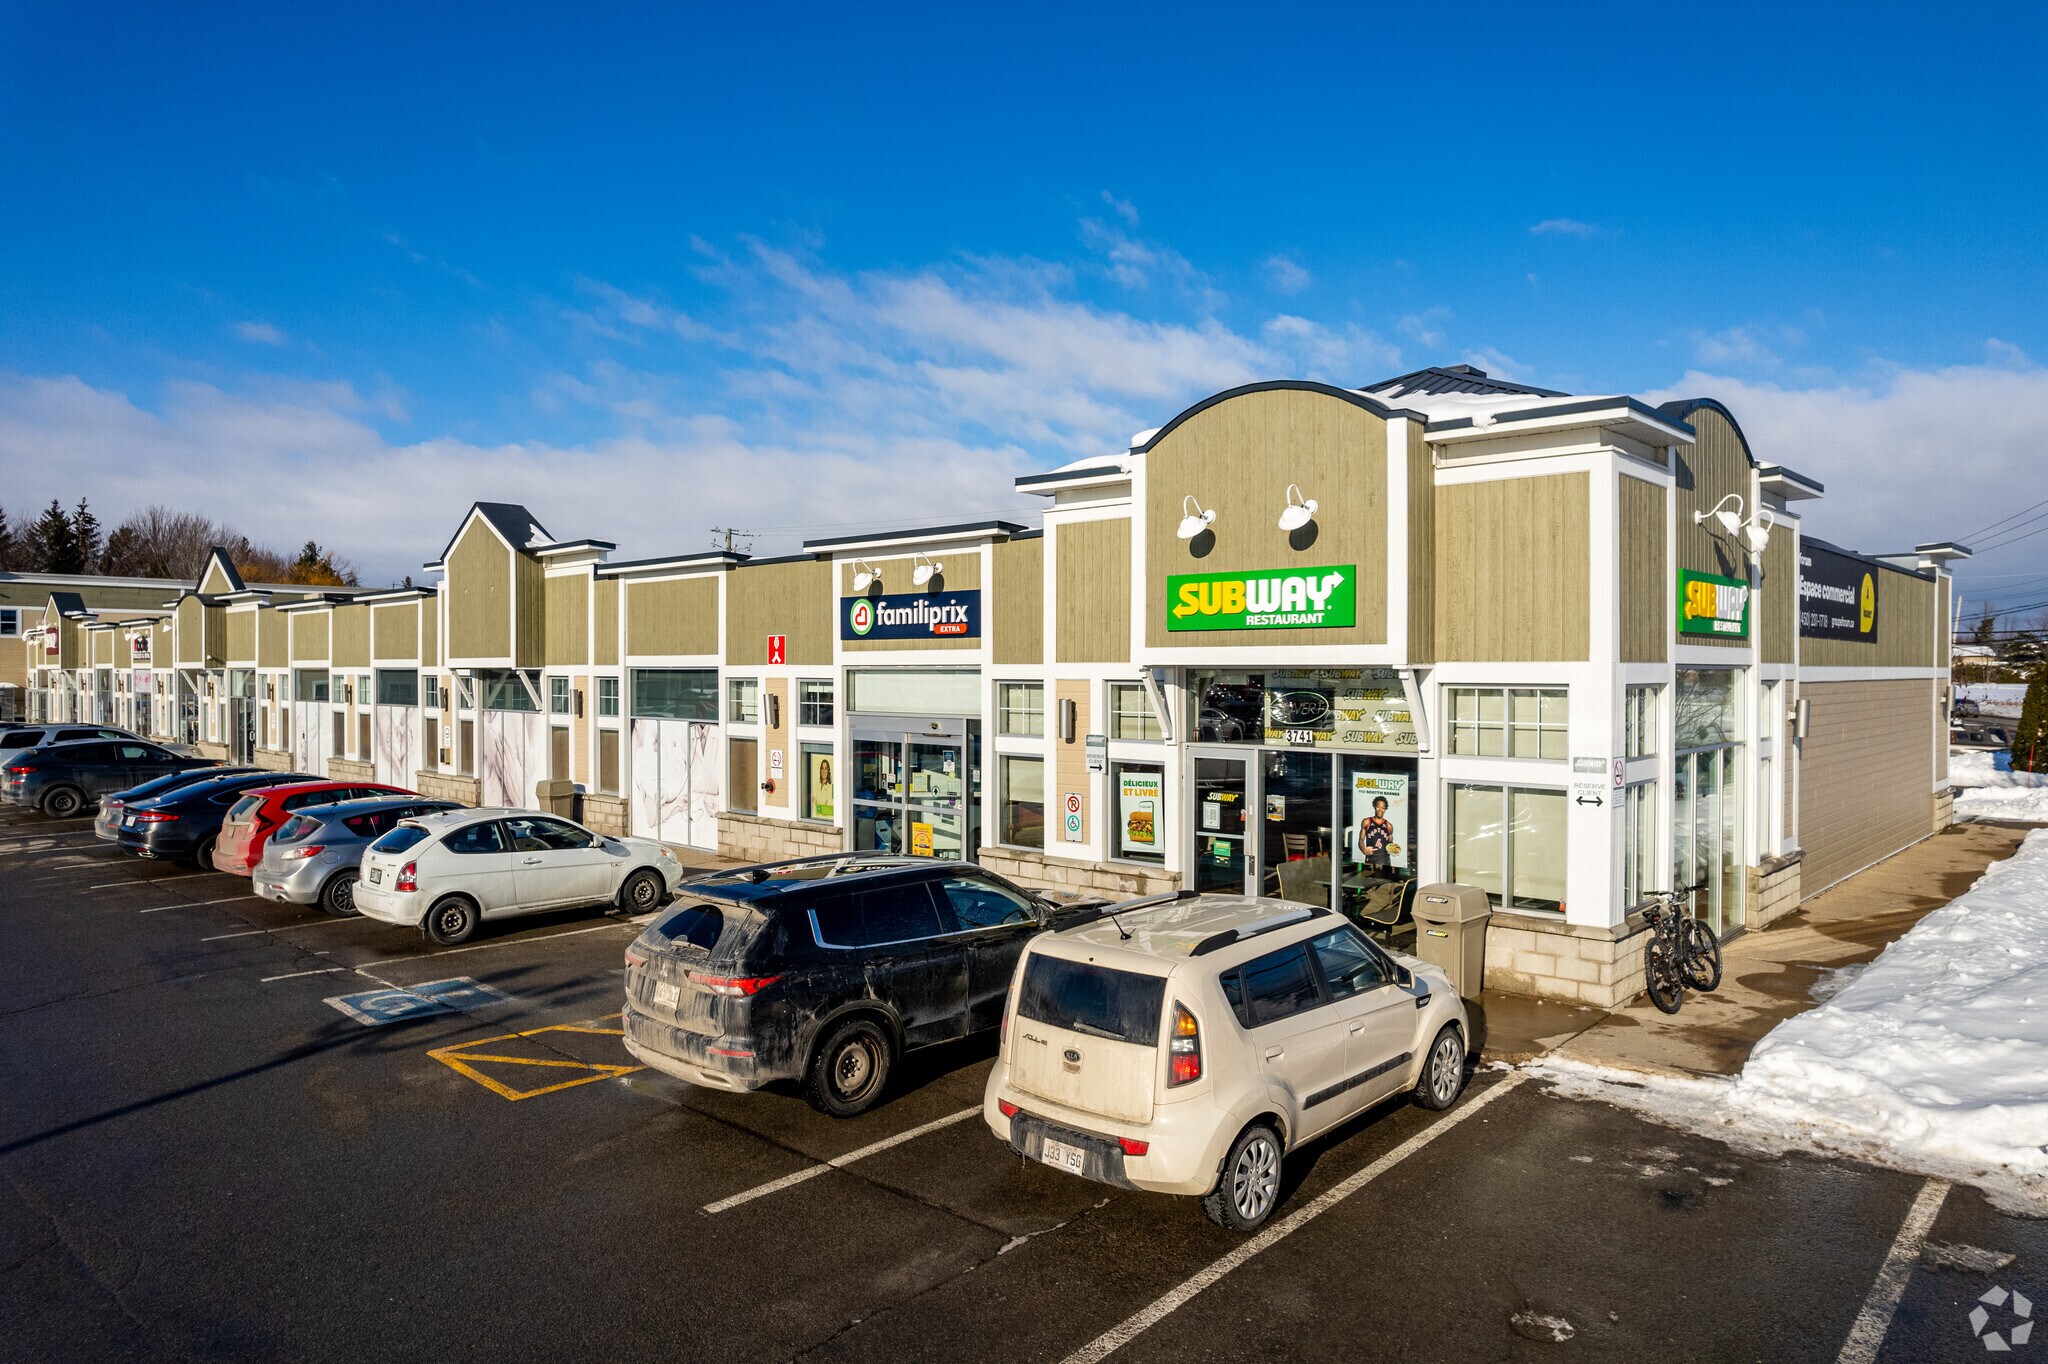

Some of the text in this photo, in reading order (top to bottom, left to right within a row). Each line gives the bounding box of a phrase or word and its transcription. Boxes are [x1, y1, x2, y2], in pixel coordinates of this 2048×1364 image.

[1172, 571, 1345, 619] SUBWAY
[1684, 580, 1749, 620] SUBWAY
[1822, 585, 1855, 605] commercial
[876, 599, 969, 632] familiprix
[1246, 613, 1325, 625] RESTAURANT
[1342, 687, 1389, 700] SUBWAY
[1286, 730, 1313, 743] 3741
[1342, 730, 1389, 743] SUBWAY
[1123, 779, 1158, 787] DÉLICIEUX
[1355, 778, 1405, 791] BOLWAY
[1123, 788, 1159, 797] ET LIVRÉ
[1207, 792, 1239, 802] SUBWAY
[1066, 1051, 1078, 1060] KIA
[1045, 1144, 1061, 1161] J33
[1066, 1150, 1082, 1168] YSG
